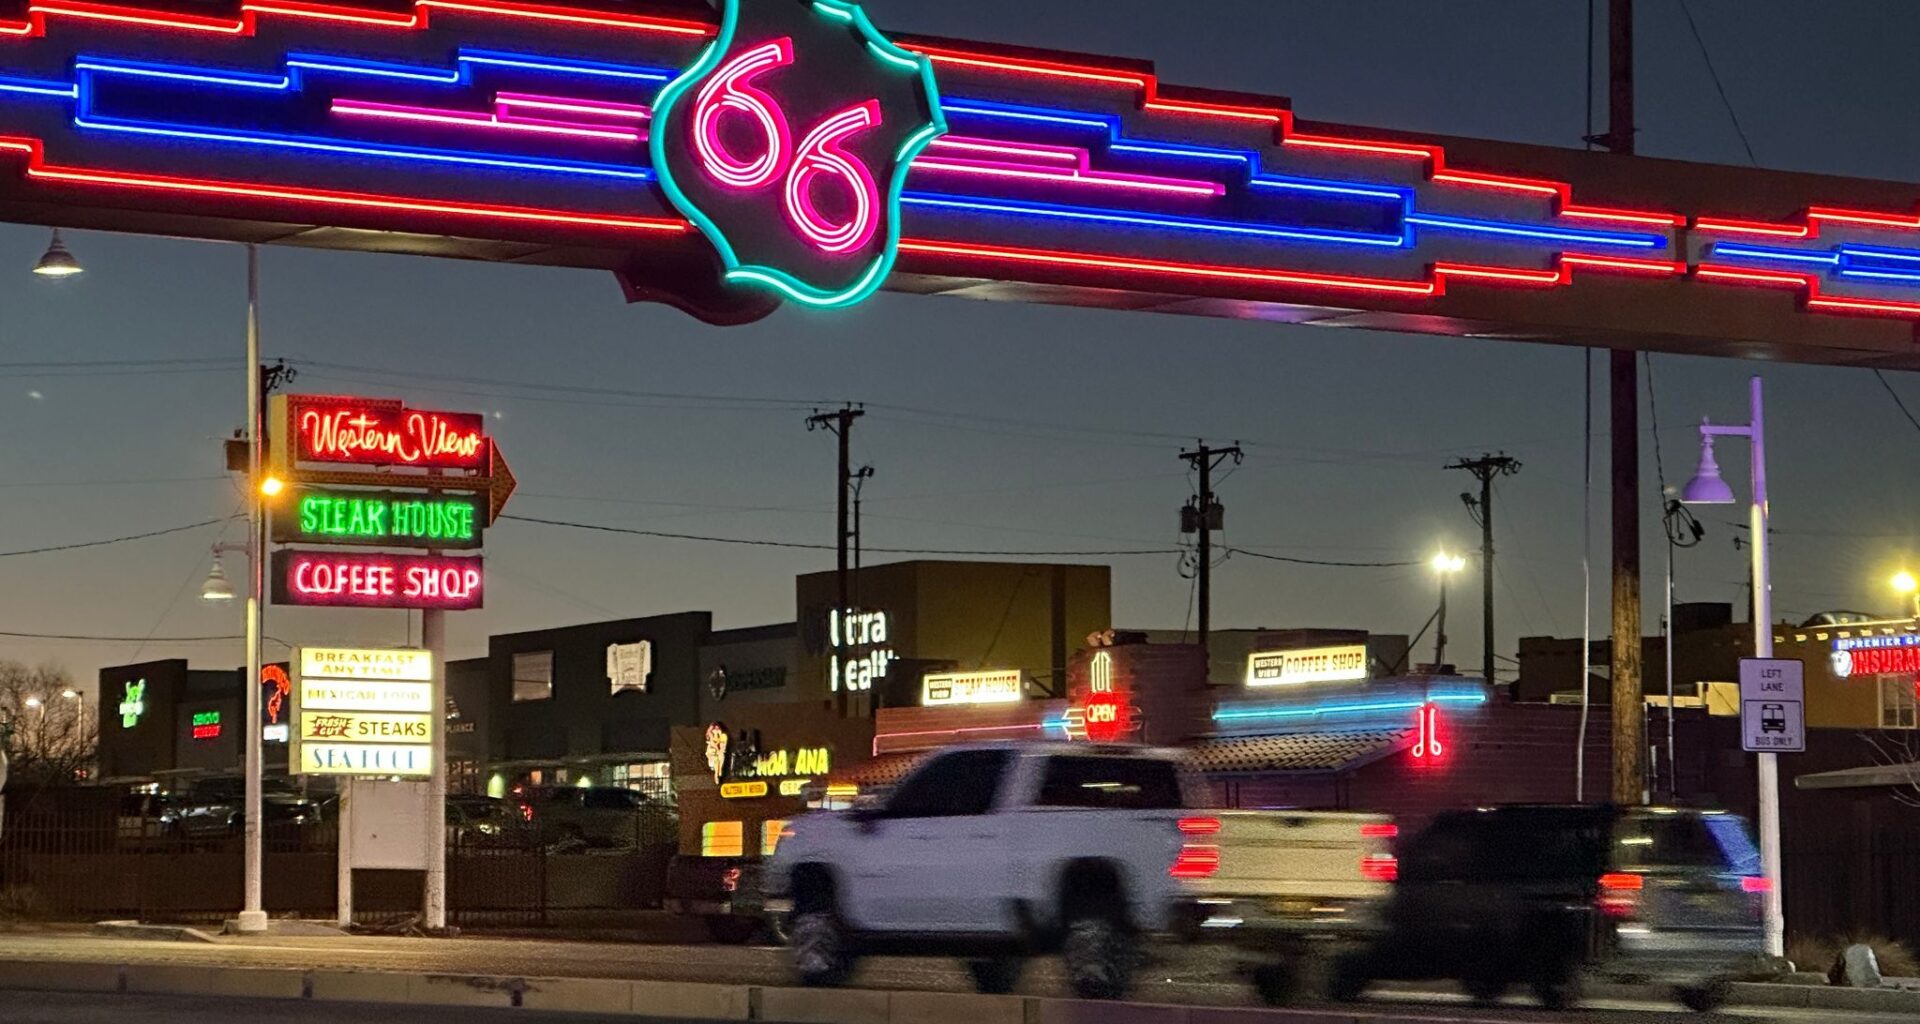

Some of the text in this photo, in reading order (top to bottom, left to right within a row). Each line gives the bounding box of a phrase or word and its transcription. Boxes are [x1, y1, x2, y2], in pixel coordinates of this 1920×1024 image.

[302, 411, 481, 461] Western View
[301, 497, 475, 539] STEAK HOUSE
[296, 562, 479, 598] COFFEE SHOP
[1849, 637, 1901, 649] PREMIER
[315, 652, 415, 664] BREAKFAST
[1287, 652, 1362, 673] COFFEE SHOP
[323, 665, 355, 674] ANY
[1761, 669, 1782, 679] LEFT
[1761, 683, 1784, 692] LANE
[1087, 704, 1117, 722] OPEN
[316, 718, 347, 728] FRESH
[358, 721, 427, 736] STEAKS
[319, 727, 343, 736] CUT
[1755, 736, 1792, 746] BUS ONLY
